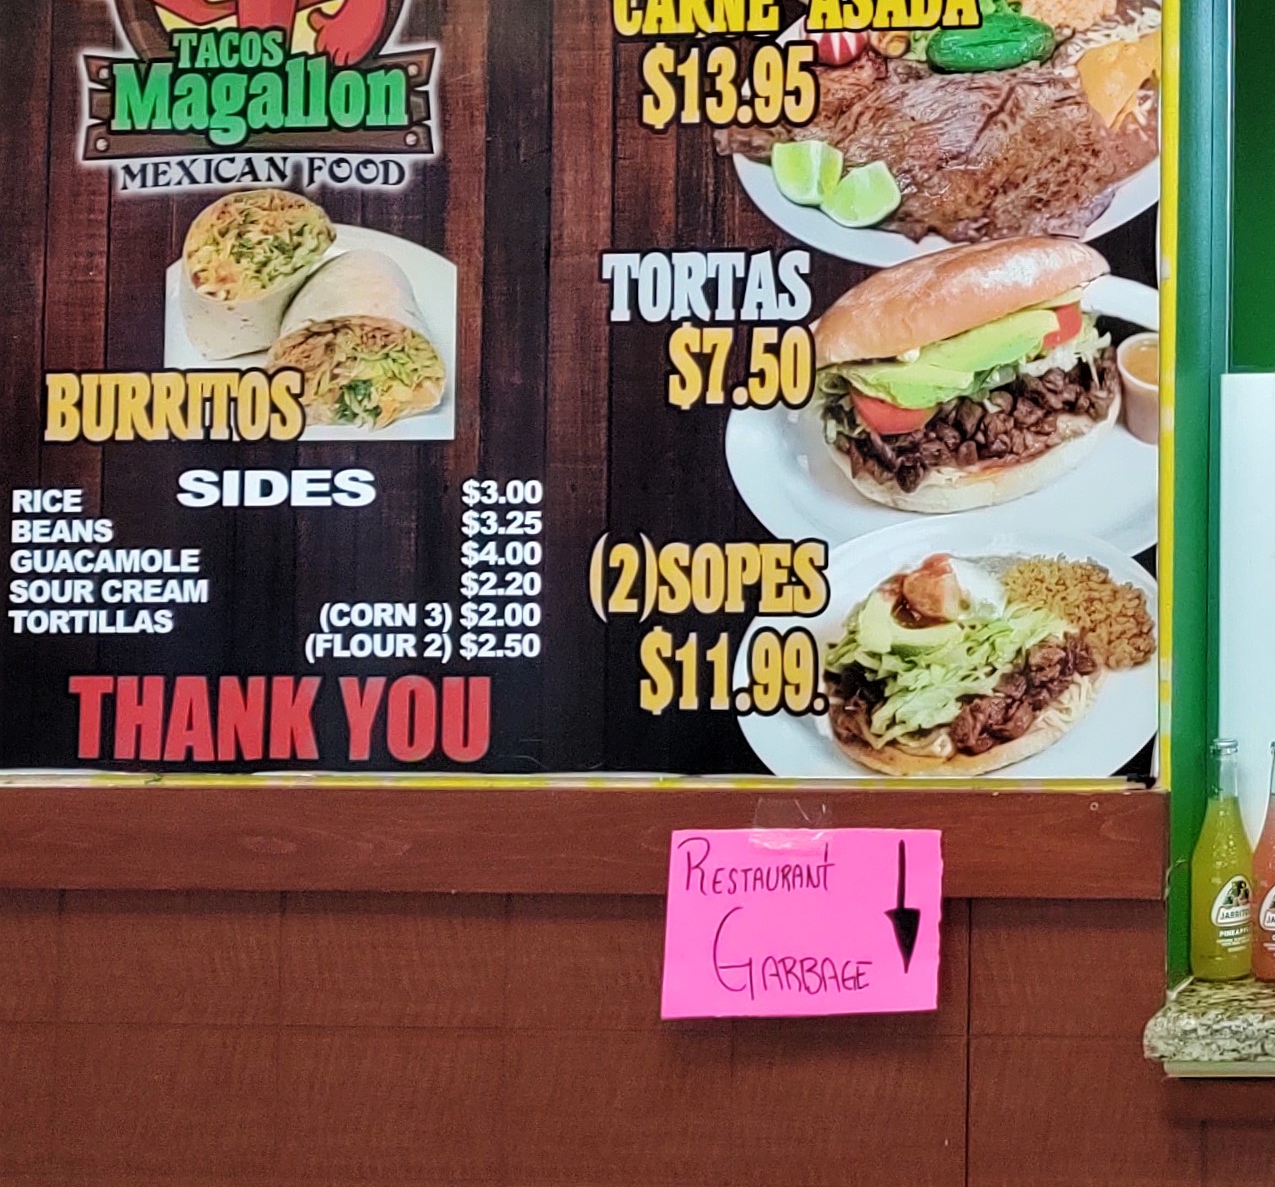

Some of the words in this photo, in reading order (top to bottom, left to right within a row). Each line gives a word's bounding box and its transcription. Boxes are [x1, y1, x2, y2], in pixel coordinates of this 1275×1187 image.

[173, 32, 284, 70] TACOS
[642, 43, 816, 129] $13.95
[111, 52, 409, 147] Magallon
[120, 157, 288, 191] MEXICAN
[307, 156, 406, 186] FOOD
[602, 250, 811, 322] TORTAS
[668, 322, 812, 409] $7.50
[45, 372, 306, 442] BURRITOS
[12, 489, 82, 513] RICE
[462, 479, 543, 506] $3.00
[177, 470, 376, 507] SIDES
[10, 550, 200, 573] GUACAMOLE
[461, 540, 542, 567] $4.00
[589, 533, 826, 622] (2)SOPES
[9, 610, 173, 634] TORTILLAS
[320, 602, 417, 630] (CORN
[424, 602, 452, 630] 3)
[460, 600, 541, 629] $2.00
[68, 675, 323, 762] THANK
[338, 675, 491, 762] YOU
[713, 907, 872, 1000] GARBAGE
